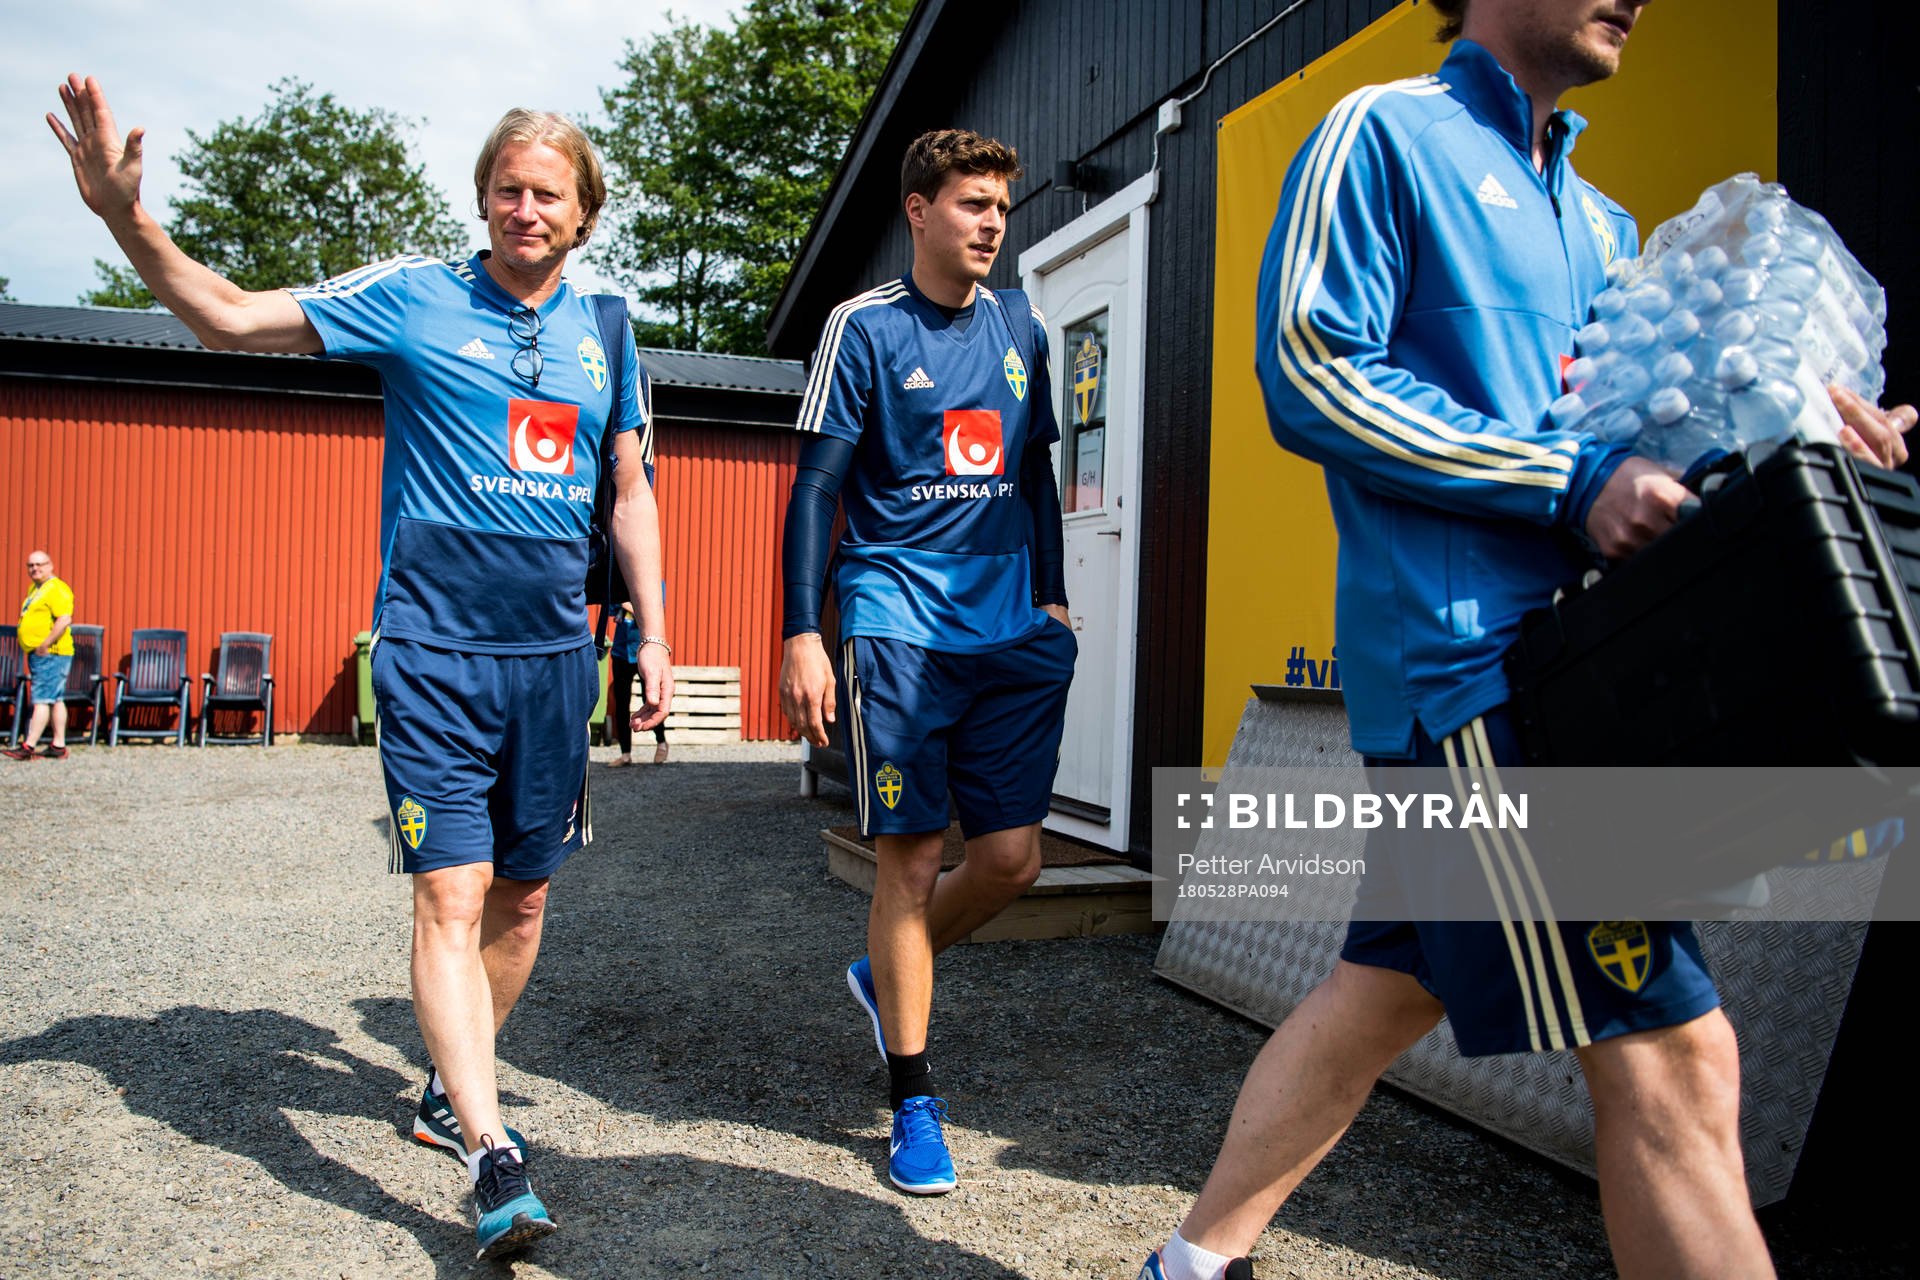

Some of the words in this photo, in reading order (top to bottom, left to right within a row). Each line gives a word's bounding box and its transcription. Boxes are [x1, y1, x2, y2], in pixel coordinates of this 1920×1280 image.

[903, 380, 935, 390] adidas
[470, 474, 564, 500] SVENSKA
[567, 484, 592, 503] SPEL
[911, 483, 992, 501] SVENSKA
